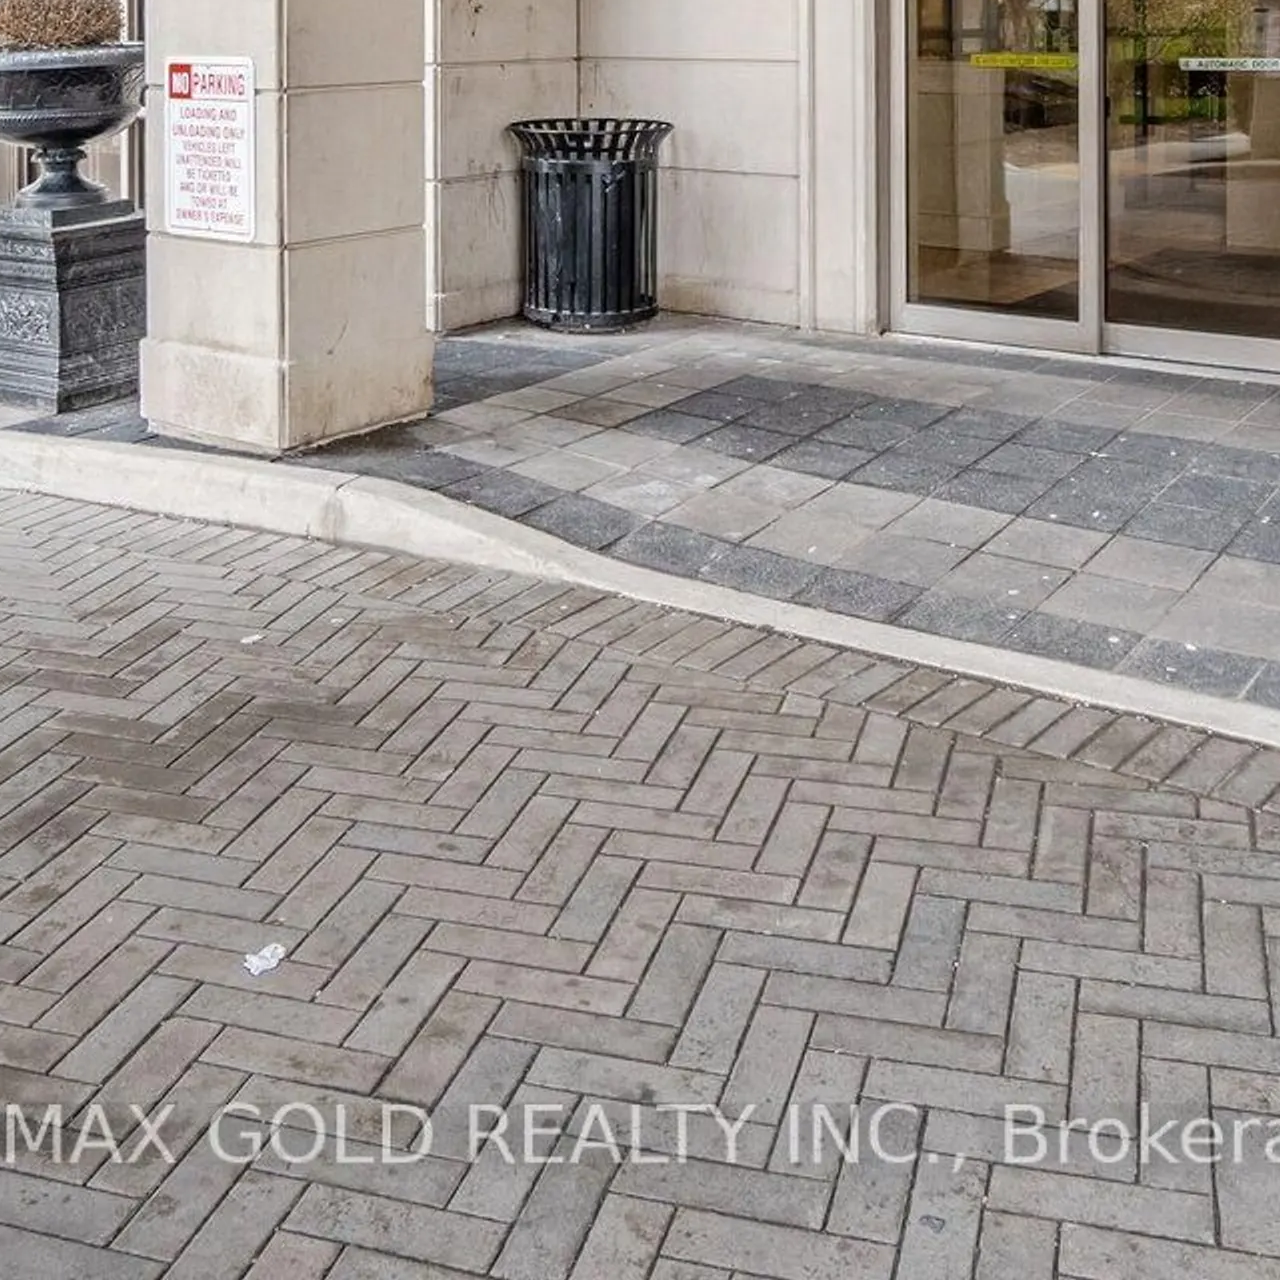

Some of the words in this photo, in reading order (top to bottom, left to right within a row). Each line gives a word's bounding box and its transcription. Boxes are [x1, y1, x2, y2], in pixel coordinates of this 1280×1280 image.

[1197, 60, 1248, 69] AUTOMATIC
[1252, 60, 1280, 69] DOOR
[172, 72, 190, 95] NO
[193, 73, 245, 96] PARKING
[180, 106, 217, 121] LOADING
[219, 109, 237, 122] AND
[172, 123, 220, 138] UNLOADING
[223, 126, 246, 139] ONLY
[183, 141, 216, 154] VEHICLES
[218, 143, 236, 155] LEFT
[176, 154, 222, 167] UNATTENDED
[186, 168, 196, 180] BE
[198, 169, 231, 182] TICKETED
